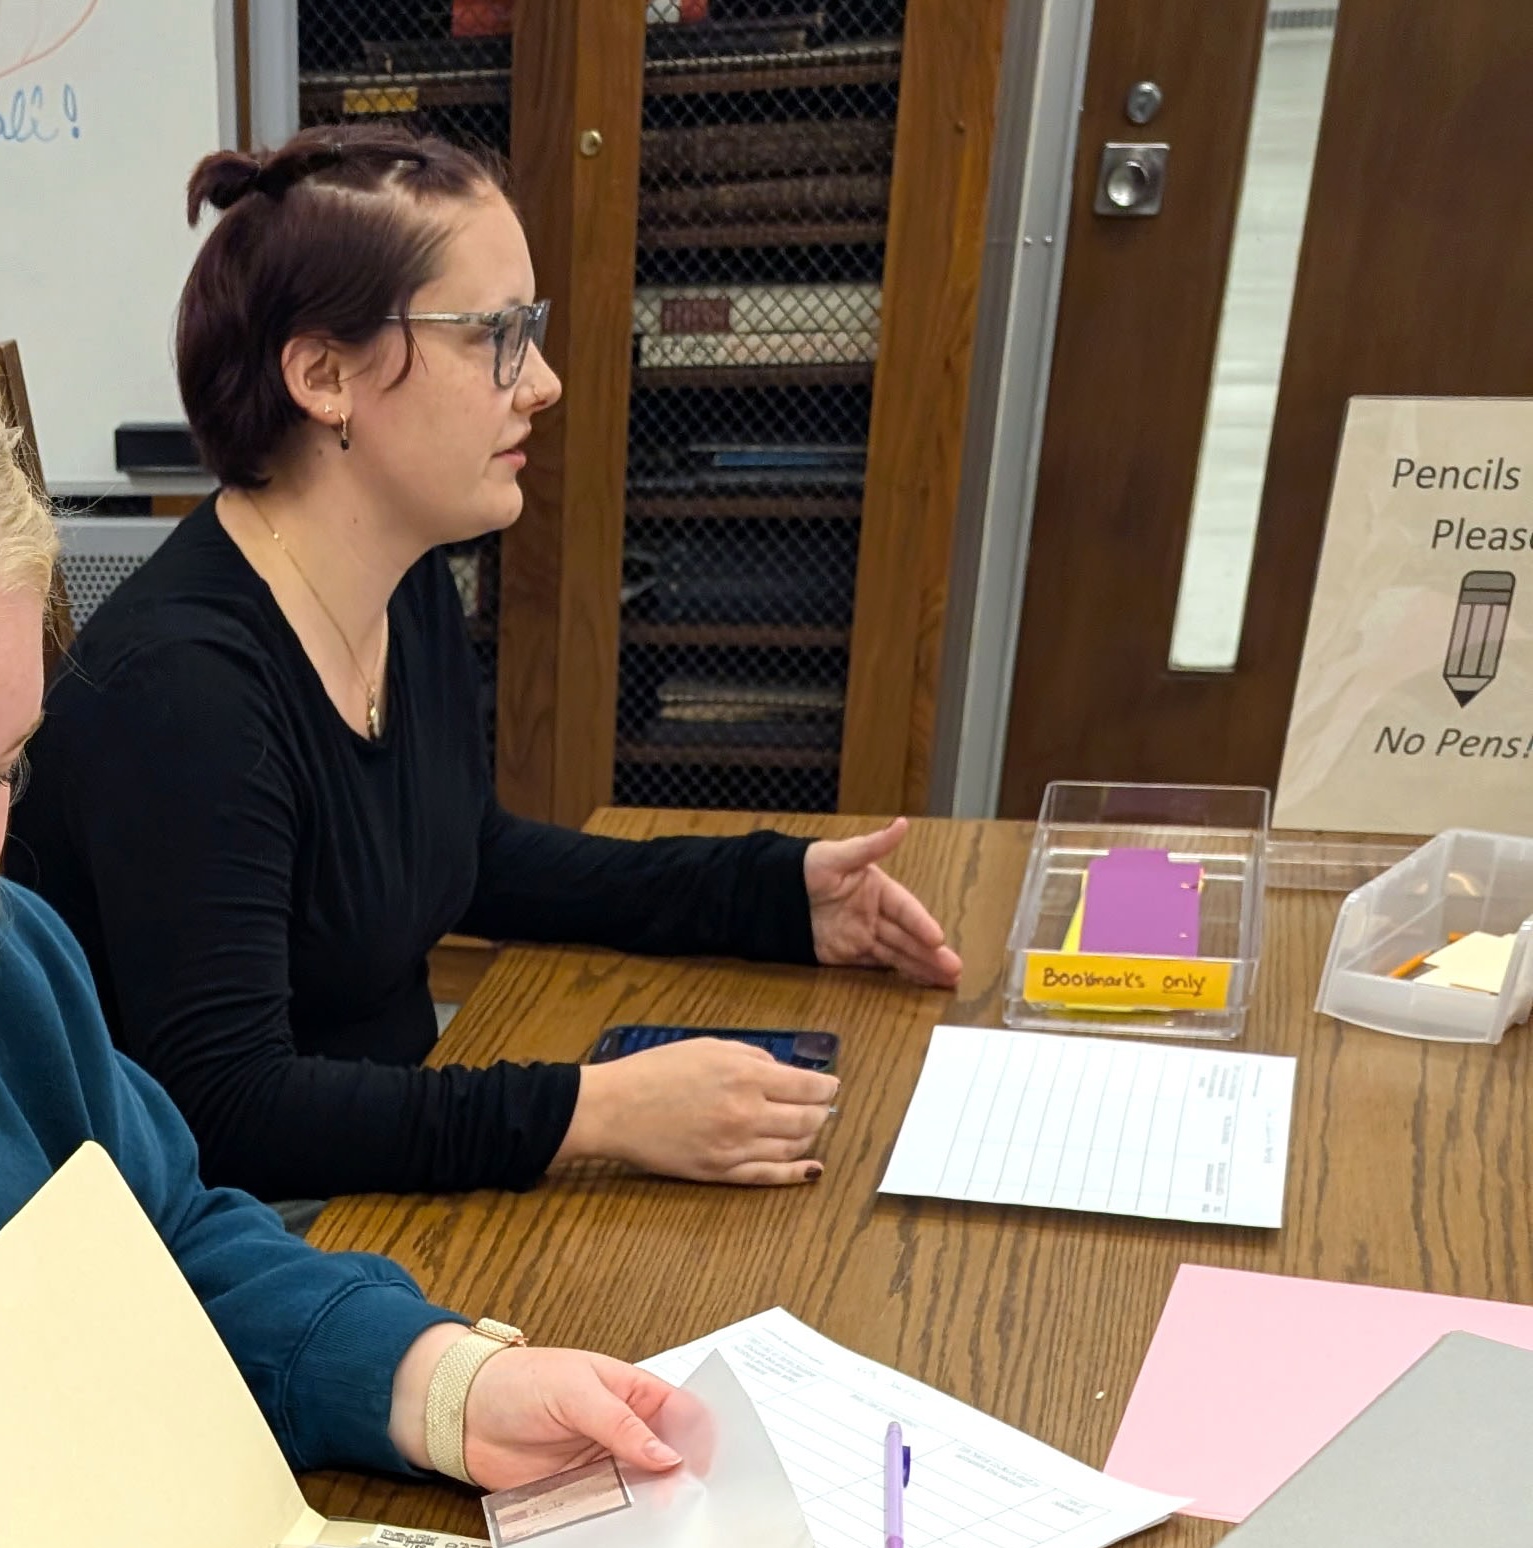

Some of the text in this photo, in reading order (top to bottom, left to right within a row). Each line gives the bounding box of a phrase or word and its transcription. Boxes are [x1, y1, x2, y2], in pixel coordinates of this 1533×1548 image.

[1392, 457, 1521, 490] Pencils
[1431, 517, 1533, 550] Pleas
[1374, 727, 1425, 755] No
[1163, 974, 1206, 996] only
